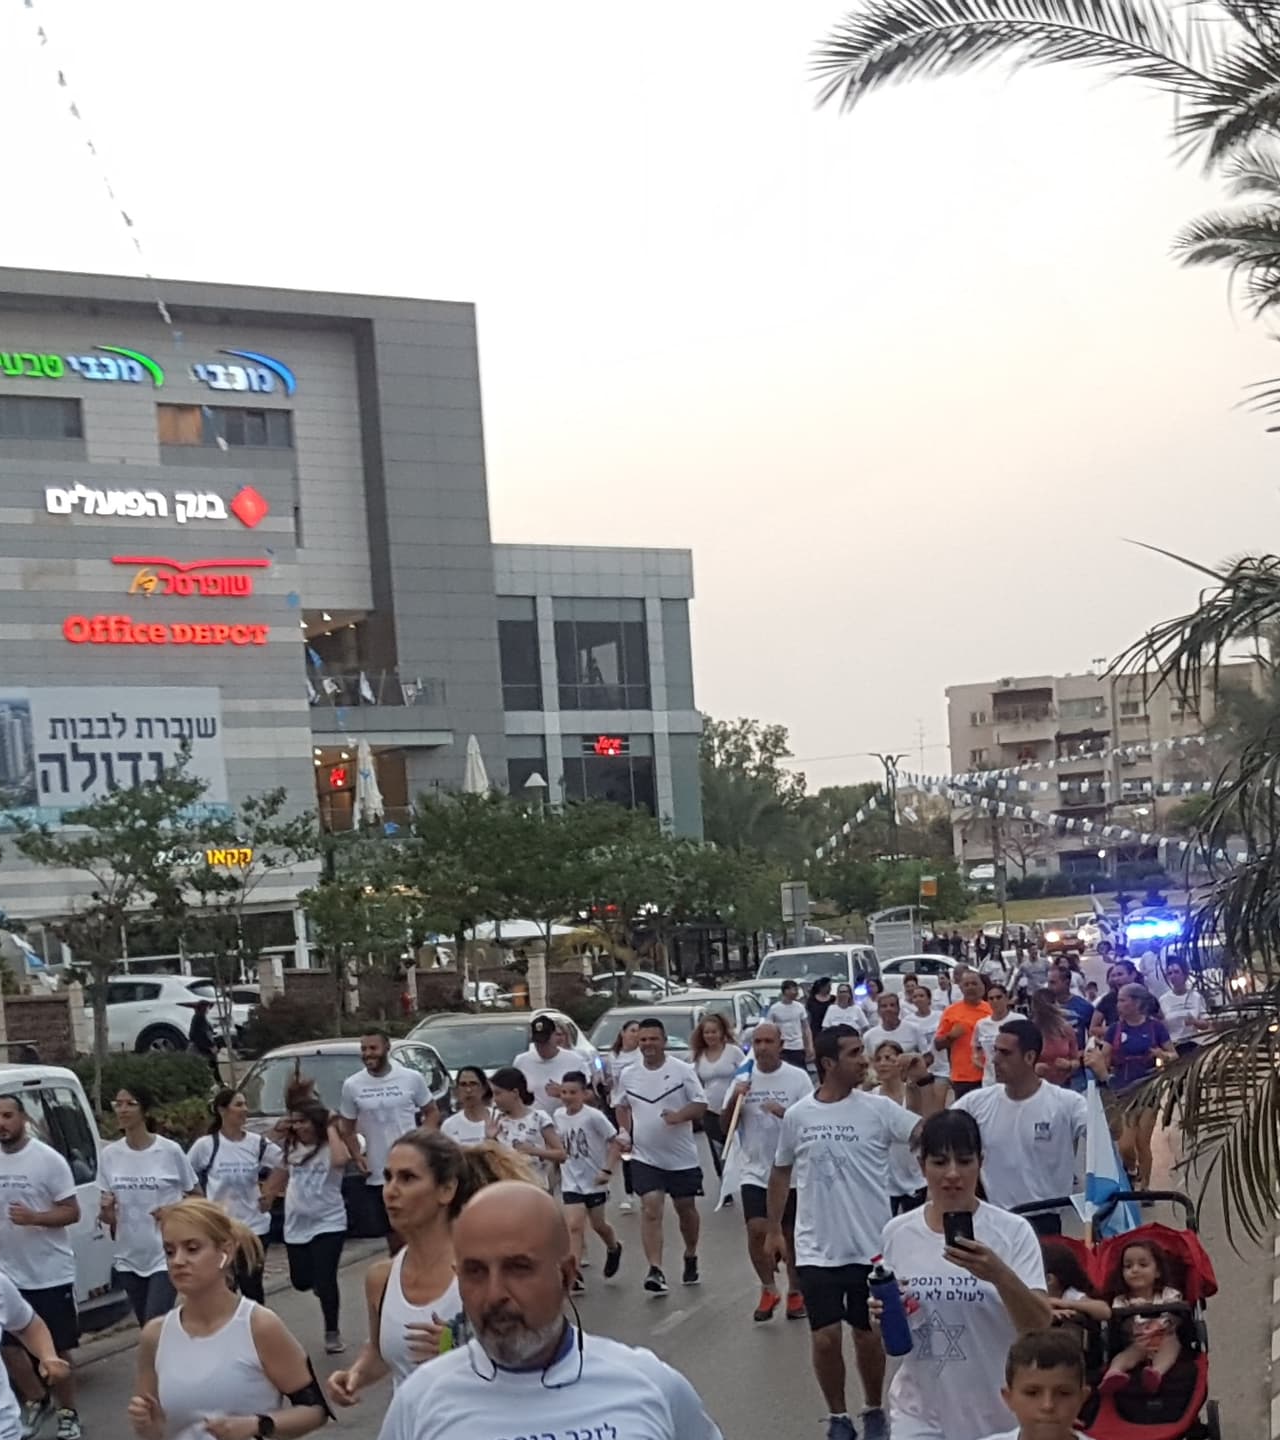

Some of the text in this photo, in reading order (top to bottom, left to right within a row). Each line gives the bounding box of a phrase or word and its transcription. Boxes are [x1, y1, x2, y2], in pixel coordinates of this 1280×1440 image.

[67, 355, 145, 382] מכבי
[194, 362, 274, 392] מכבי
[46, 480, 228, 523] בנק הפועלים
[158, 569, 254, 597] שופרסל
[64, 615, 270, 645] Office DEPOT
[49, 712, 126, 740] לבבות
[39, 742, 164, 793] גדולה
[206, 848, 254, 869] קקאו
[925, 1287, 942, 1301] לא
[948, 1274, 978, 1287] לזכר
[946, 1289, 985, 1302] לעולם
